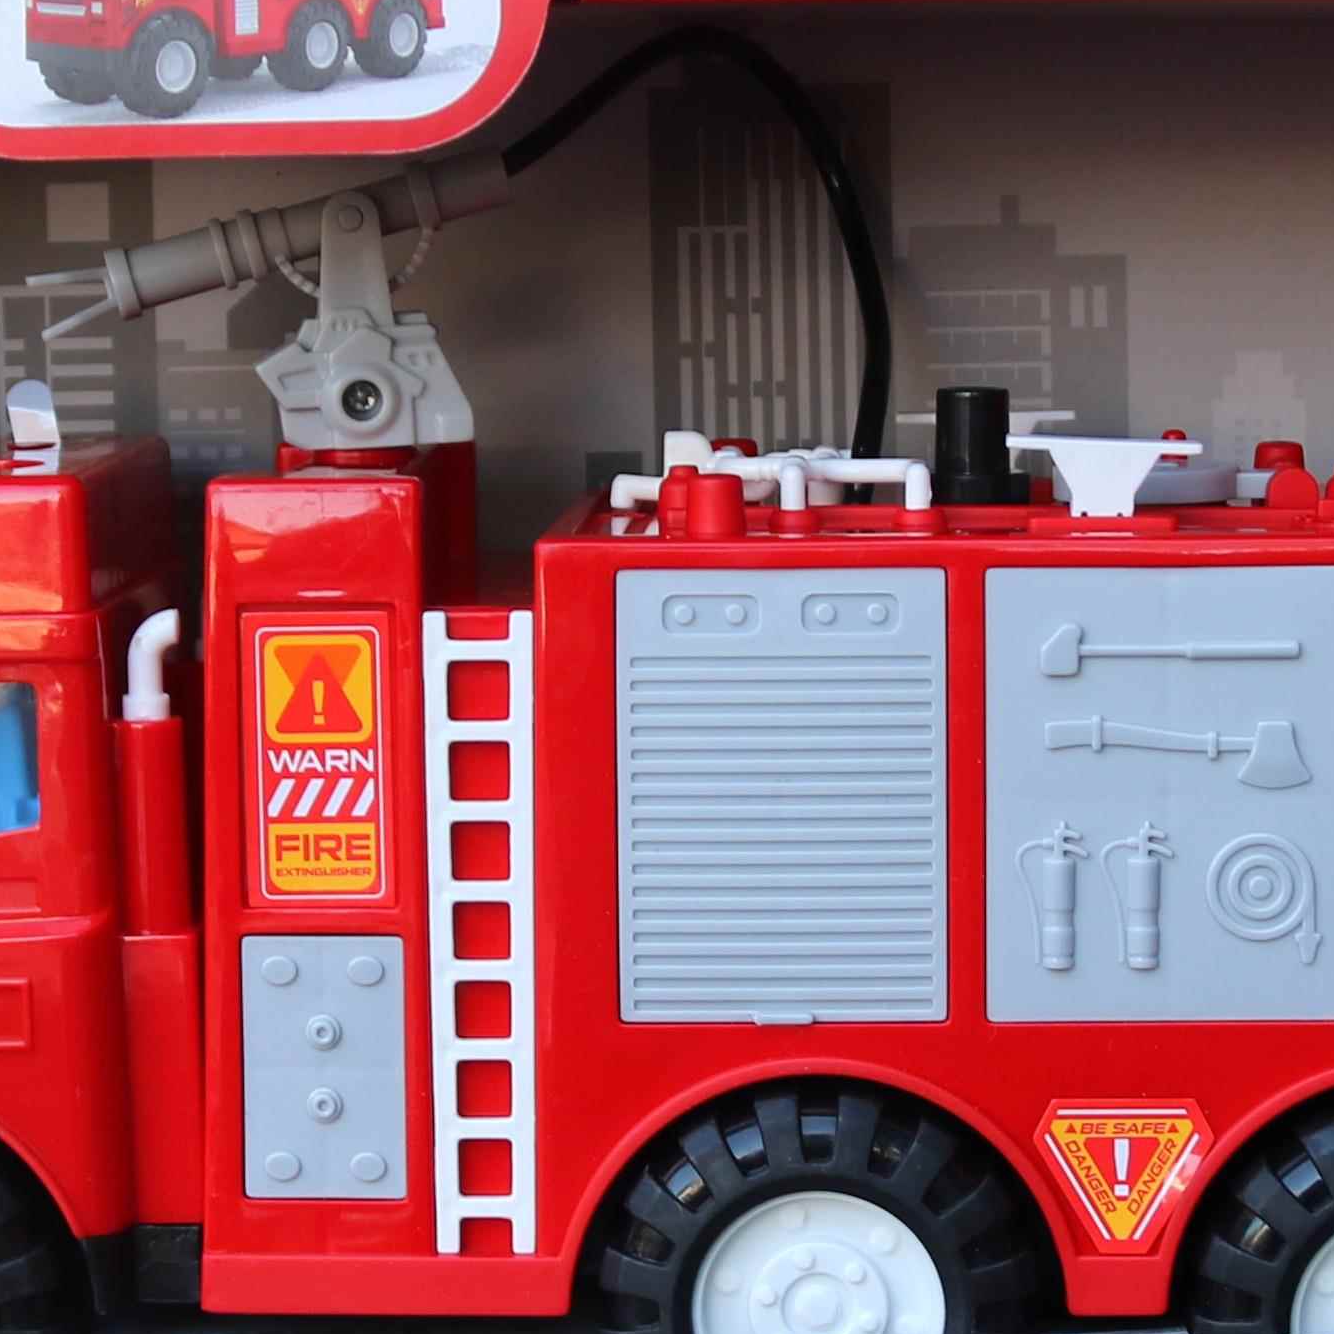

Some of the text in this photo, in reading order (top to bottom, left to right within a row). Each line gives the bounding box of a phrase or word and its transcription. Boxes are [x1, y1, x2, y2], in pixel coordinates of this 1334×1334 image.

[267, 748, 375, 774] WARN
[275, 833, 372, 862] FIRE
[275, 866, 372, 878] EXTINGUISHER
[1080, 1122, 1167, 1135] BE SAFE
[1064, 1139, 1117, 1215] DANGER
[1126, 1138, 1179, 1216] DANGER
